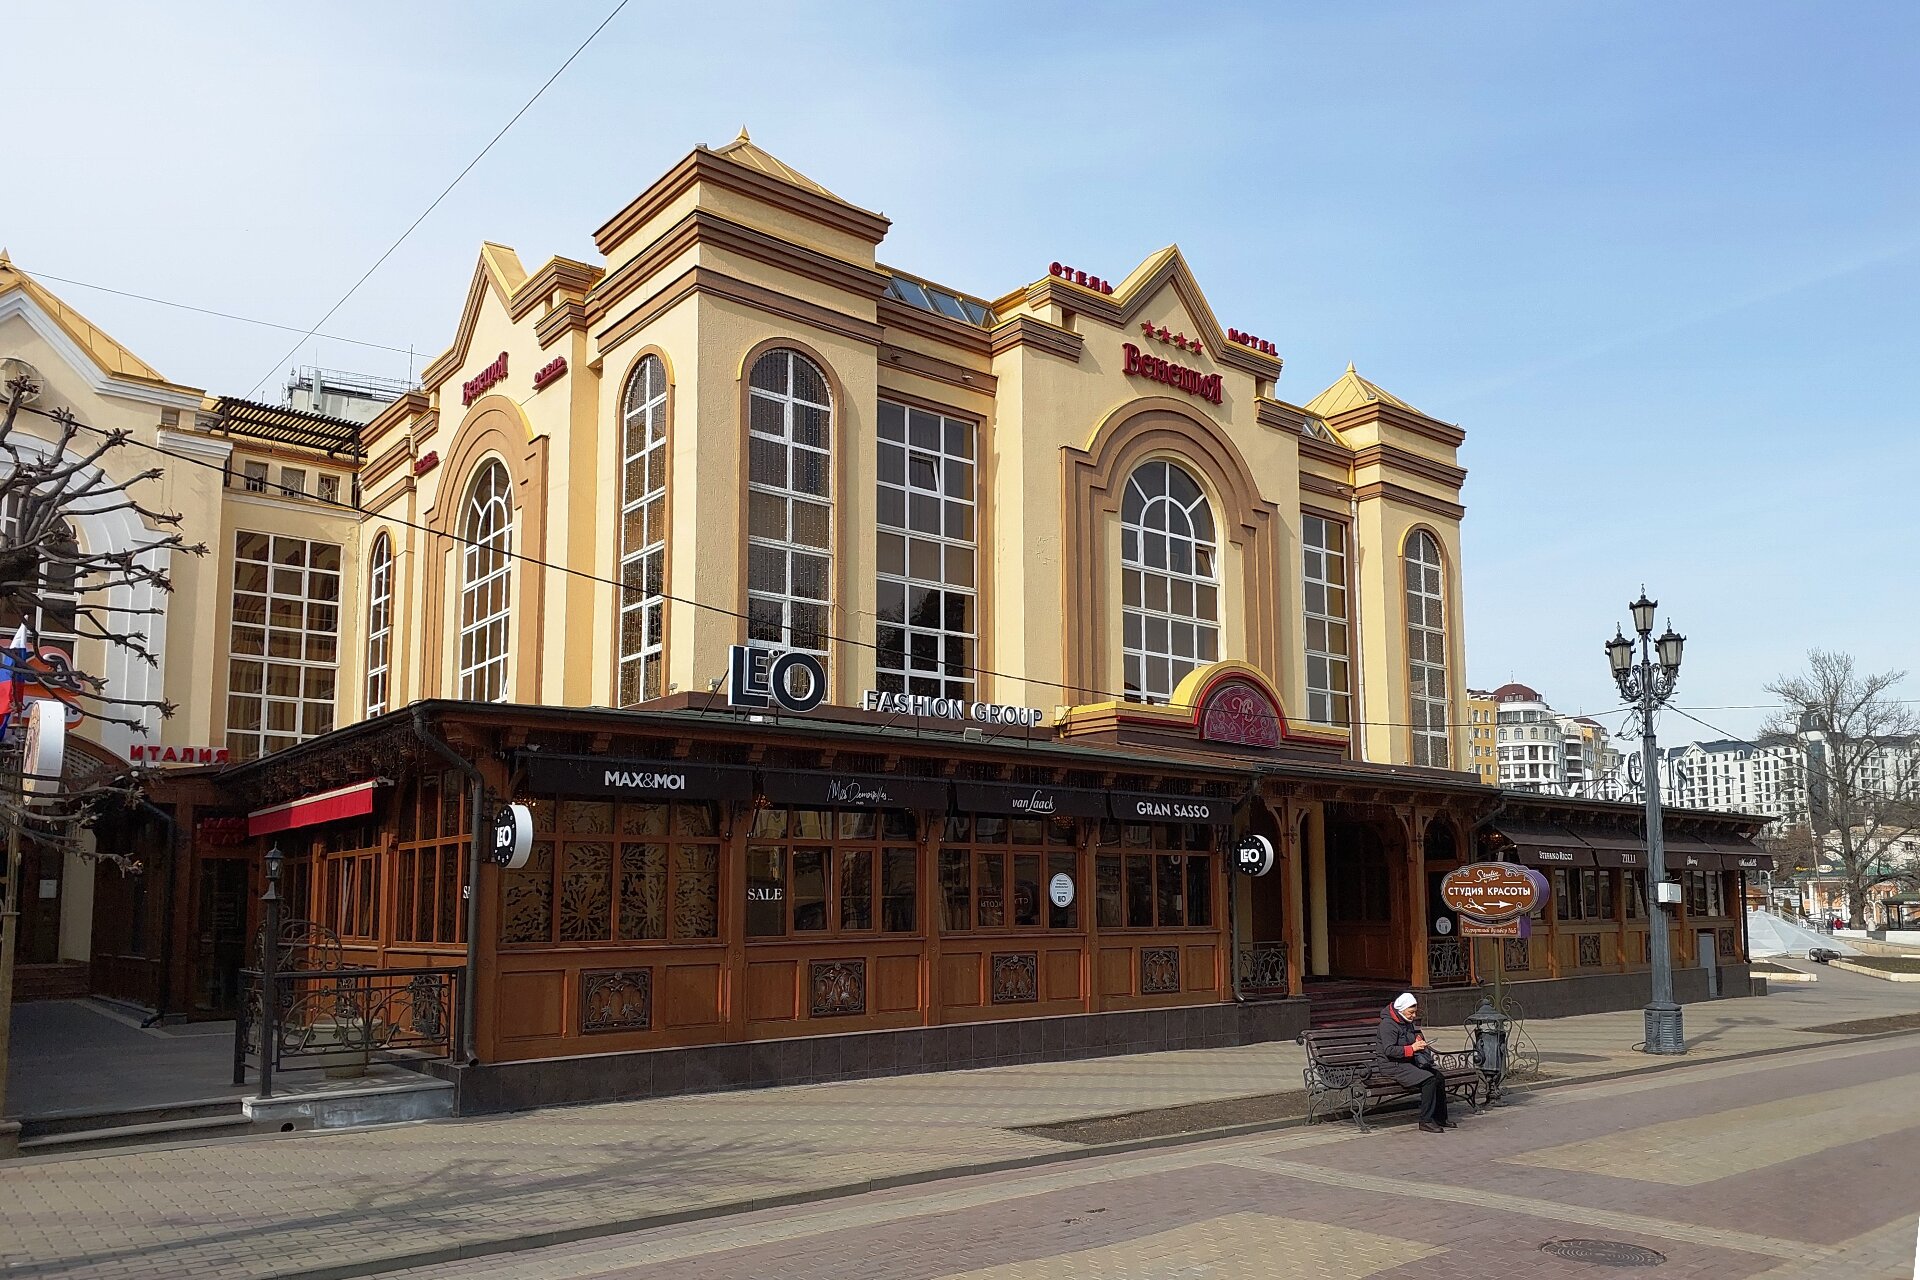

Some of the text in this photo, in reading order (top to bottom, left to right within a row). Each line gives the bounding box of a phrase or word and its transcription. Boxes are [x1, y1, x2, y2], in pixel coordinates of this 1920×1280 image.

[1049, 261, 1113, 295] ОТЕЛЬ
[1227, 327, 1279, 357] HOTEL
[728, 645, 827, 713] LEO
[863, 689, 1044, 727] FASHION GROUP
[129, 744, 230, 764] ИТАЛИЯ
[604, 770, 685, 790] MAX&MOI
[1012, 789, 1057, 814] van Laack
[1136, 801, 1210, 818] GRAN SASSO
[496, 825, 511, 848] LEO
[1240, 848, 1260, 863] LEO
[747, 887, 783, 900] SALE
[1447, 887, 1531, 896] СТУДИЯ КРАСОТЫ
